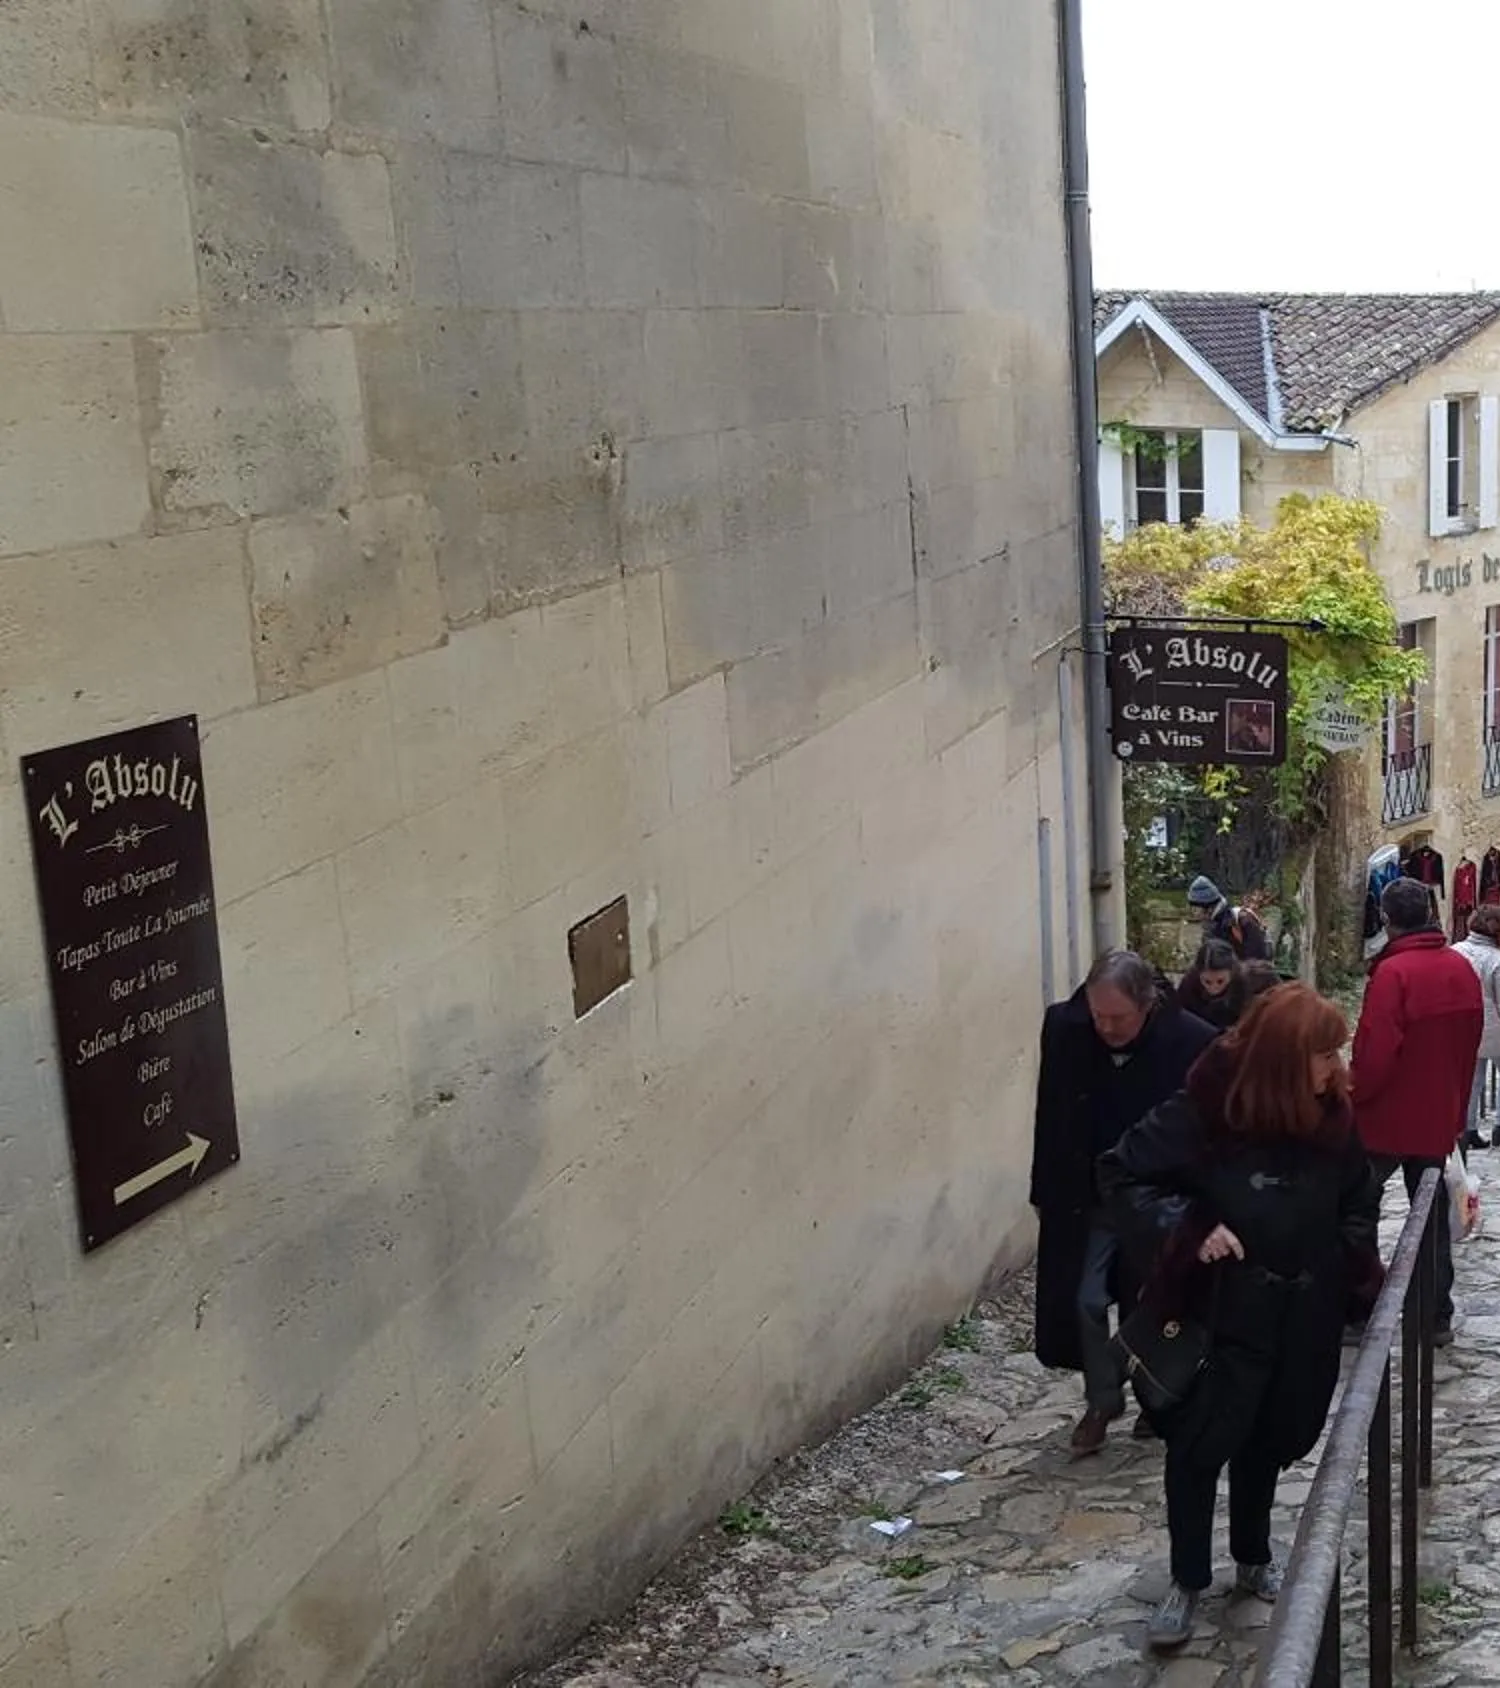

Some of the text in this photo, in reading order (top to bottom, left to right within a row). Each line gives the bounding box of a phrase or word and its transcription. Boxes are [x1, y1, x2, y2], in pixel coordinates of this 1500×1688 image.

[1416, 556, 1473, 596] Logis
[1483, 553, 1500, 583] de
[1122, 704, 1219, 723] Café Bar
[1138, 730, 1204, 747] à Vins
[83, 860, 179, 907] Petit Déjeuner
[57, 897, 211, 972] Tapas Toute La Journée
[109, 977, 134, 1001] Bar
[148, 960, 178, 983] Vins
[76, 987, 216, 1066] Salon de Dégustation
[137, 1056, 171, 1084] Bière
[143, 1095, 173, 1129] Café
